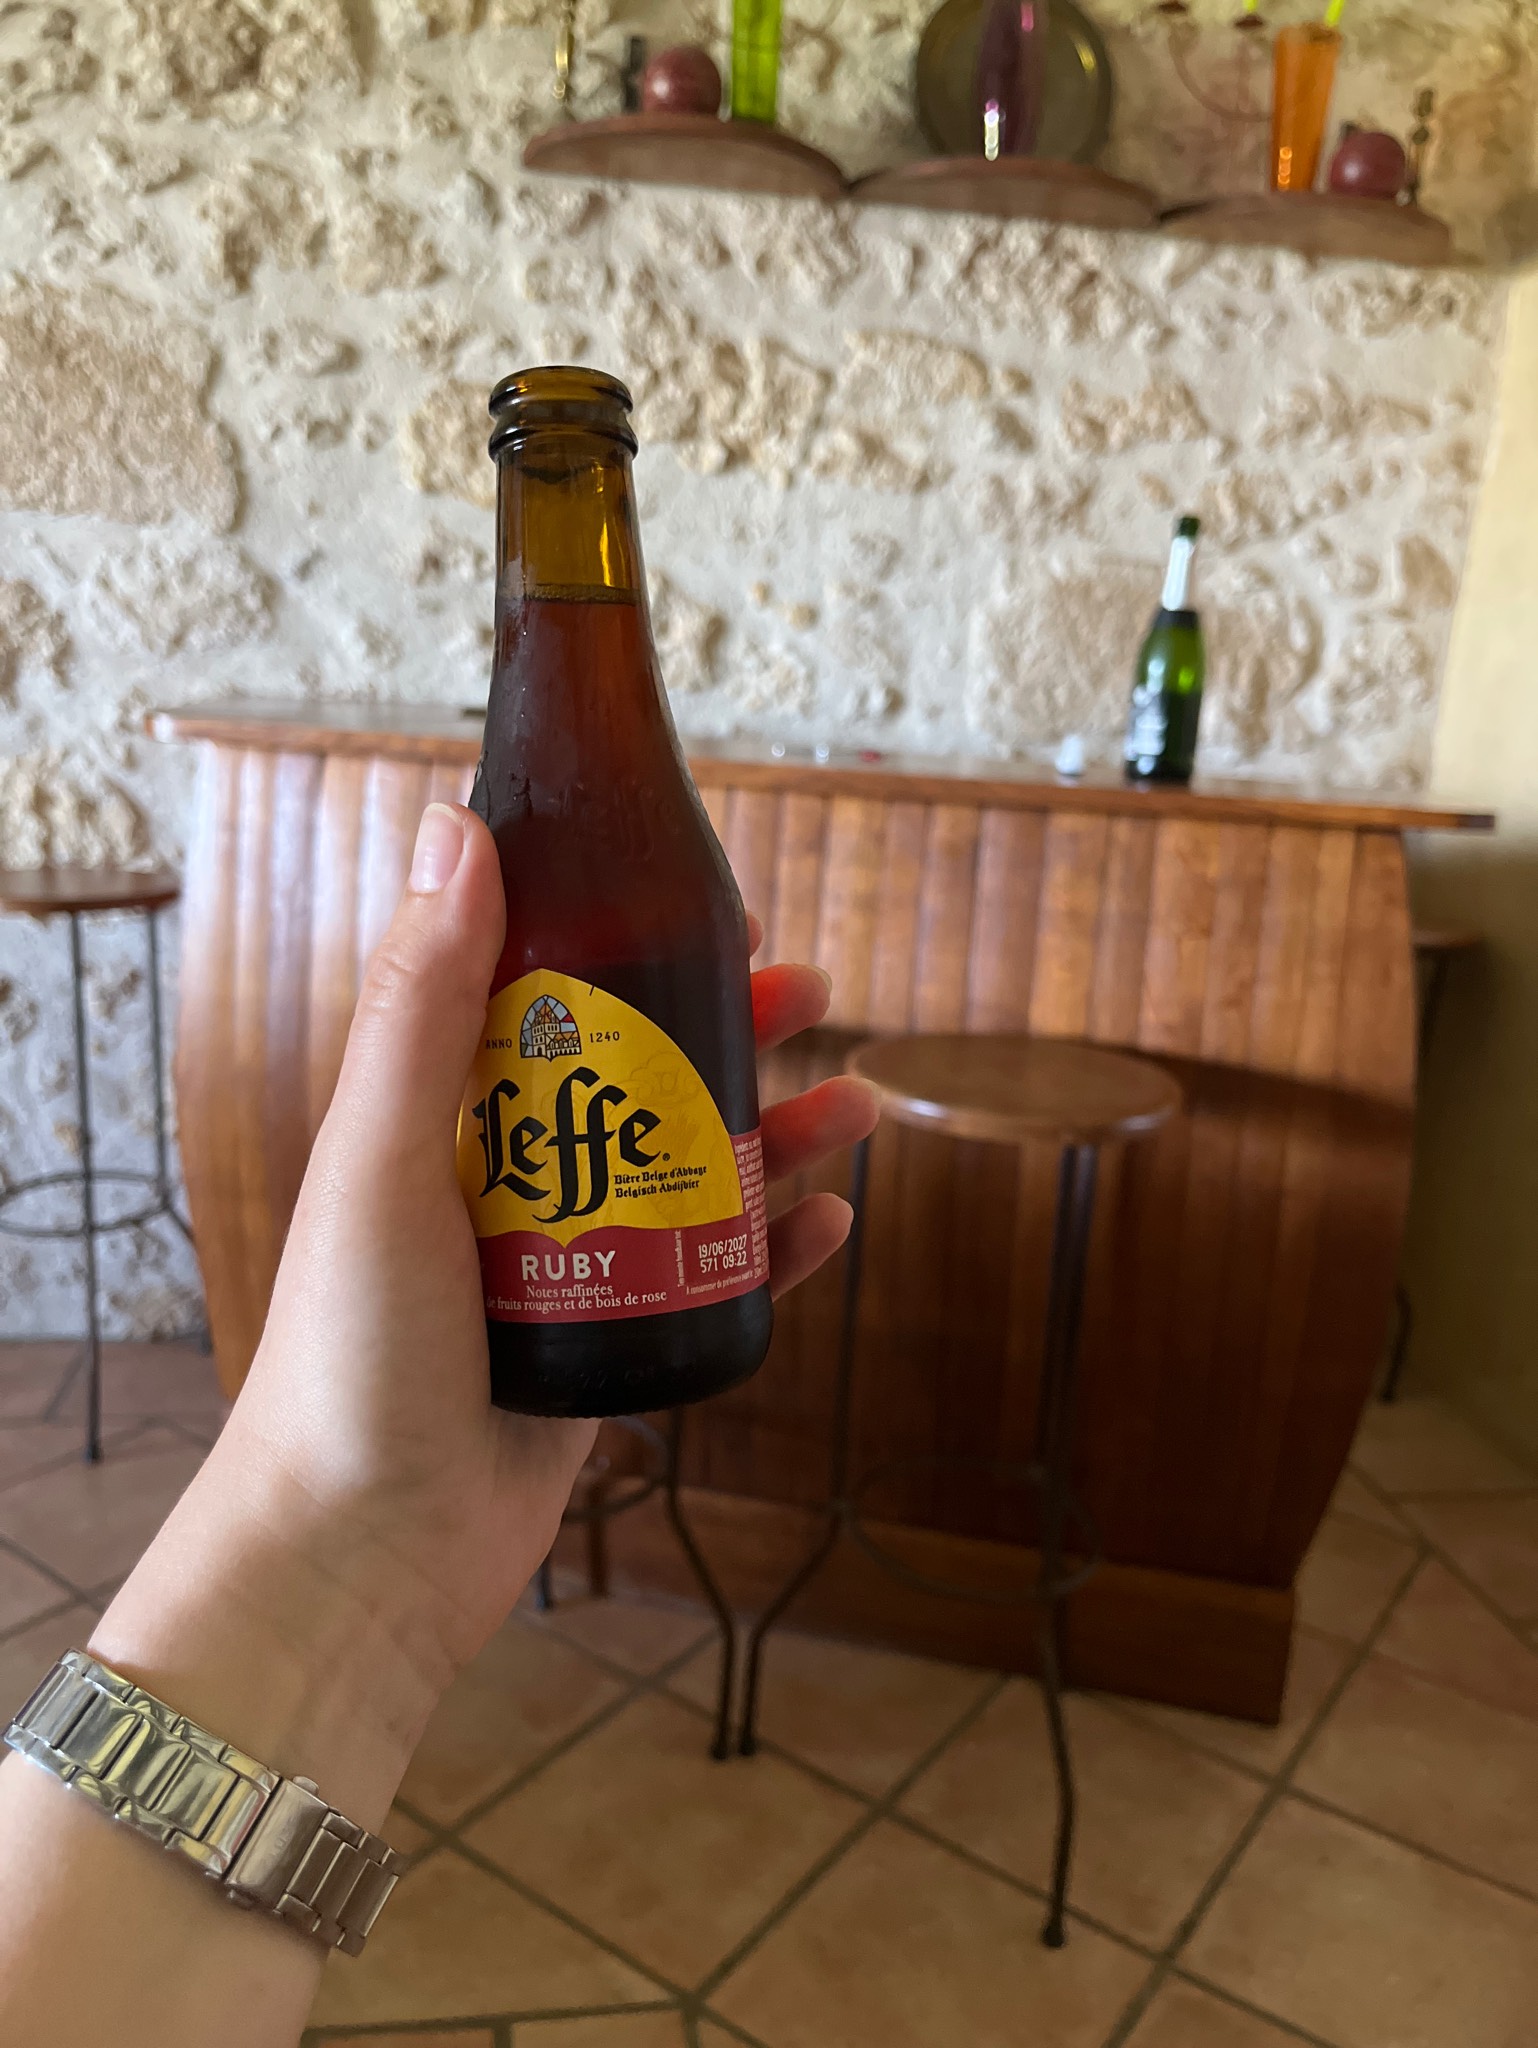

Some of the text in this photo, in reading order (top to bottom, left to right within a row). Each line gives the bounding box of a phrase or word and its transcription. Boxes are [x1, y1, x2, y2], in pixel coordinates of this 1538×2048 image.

[485, 1038, 513, 1050] ANNO
[590, 1030, 621, 1043] 1240
[472, 1066, 661, 1223] Leffe
[614, 1173, 640, 1185] Bière
[641, 1170, 668, 1182] Belge
[615, 1179, 700, 1198] Belgisch Abdijbier
[698, 1233, 747, 1258] 19/06/2027
[521, 1250, 616, 1281] RUBY
[700, 1250, 747, 1273] 571 09:22
[526, 1283, 613, 1298] Notes raffinées
[498, 1296, 522, 1310] fruits
[524, 1300, 561, 1315] rouges
[563, 1299, 575, 1310] et
[578, 1297, 592, 1310] de
[596, 1295, 621, 1309] bois
[624, 1292, 639, 1306] de
[642, 1291, 667, 1304] rose
